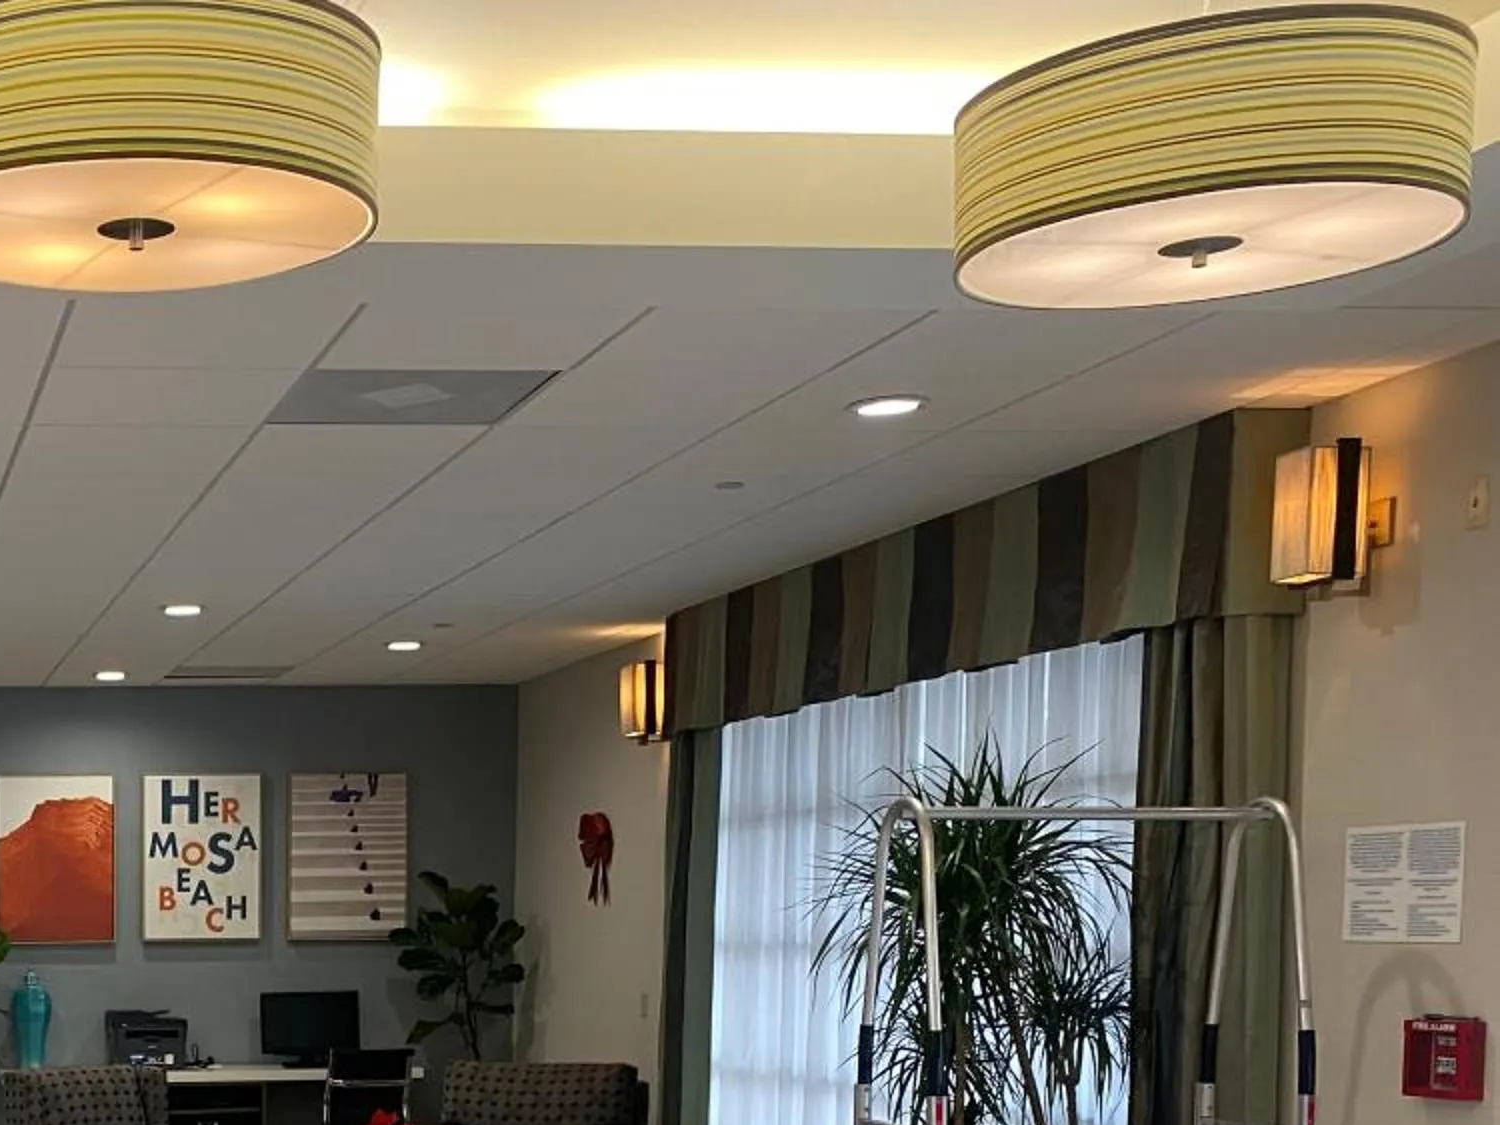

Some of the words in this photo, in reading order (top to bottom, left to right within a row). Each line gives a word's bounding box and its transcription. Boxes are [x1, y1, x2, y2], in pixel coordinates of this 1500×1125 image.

[161, 779, 240, 824] HER
[149, 825, 258, 874] MOSA
[159, 868, 247, 932] BEACH
